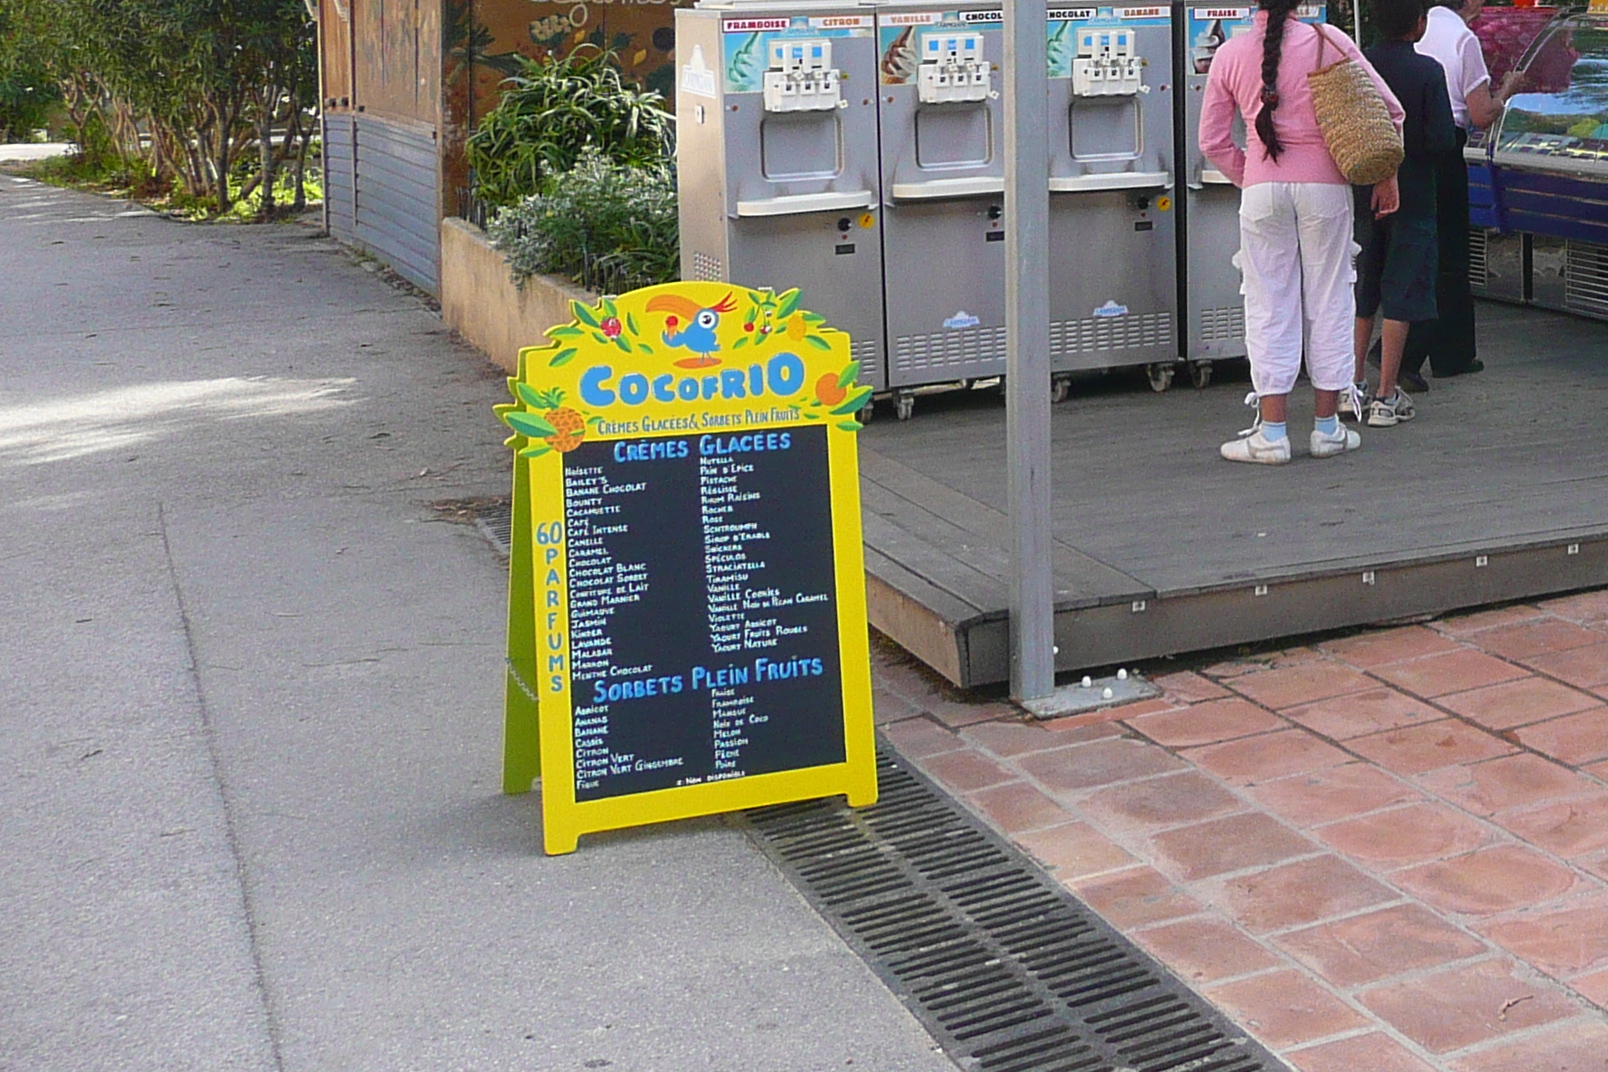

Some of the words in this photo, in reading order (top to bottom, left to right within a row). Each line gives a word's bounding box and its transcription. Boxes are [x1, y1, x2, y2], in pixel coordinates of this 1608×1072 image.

[965, 12, 1003, 21] CHOCOL
[1046, 10, 1091, 19] HOCOLAT
[1124, 8, 1160, 16] BANANE
[822, 18, 860, 26] CITRON
[891, 15, 931, 23] VANILLE
[727, 20, 787, 30] FRAMBOISE
[598, 419, 639, 435] CRÈMES
[701, 411, 742, 427] SORBETS
[745, 409, 768, 423] PLEIN
[770, 407, 800, 422] FRUITS
[614, 439, 689, 463] CRÈMES
[699, 431, 791, 456] GLACÉES
[700, 457, 733, 465] NUTELLA
[700, 476, 737, 485] PISTACHE
[565, 487, 599, 497] BANANE
[603, 482, 647, 494] CHOCOLAT
[566, 498, 602, 508] BOUNTY
[536, 521, 562, 545] 60
[592, 525, 628, 535] INTENSE
[568, 548, 609, 558] CARAMEL
[569, 557, 612, 567] CHOCOLAT
[569, 566, 613, 577] CHOCOLAT
[616, 563, 646, 573] BLANC
[569, 576, 613, 588] CHOCOLAT
[706, 573, 749, 583] TIRAMISU
[707, 583, 740, 592] VANILLE
[570, 599, 598, 608] GRAND
[601, 594, 640, 605] MARNIER
[707, 592, 740, 603] VANILLE
[545, 548, 564, 692] PARFUMS
[708, 613, 745, 622] VIOLETTE
[571, 637, 612, 649] LAVANDE
[744, 638, 778, 649] NATURE
[610, 664, 653, 676] CHOCOLAT
[593, 675, 682, 703] SORBETS
[691, 664, 748, 690] PLEIN
[755, 656, 823, 682] FRUITS
[575, 726, 608, 737] BANANE
[713, 729, 741, 738] MELON
[575, 737, 603, 748] CASSIS
[714, 738, 748, 749] PASSION
[576, 748, 609, 758] CITRON
[576, 758, 608, 768] CITRON
[610, 753, 635, 763] VERT
[576, 769, 607, 779] CITRON
[610, 764, 632, 774] VERT
